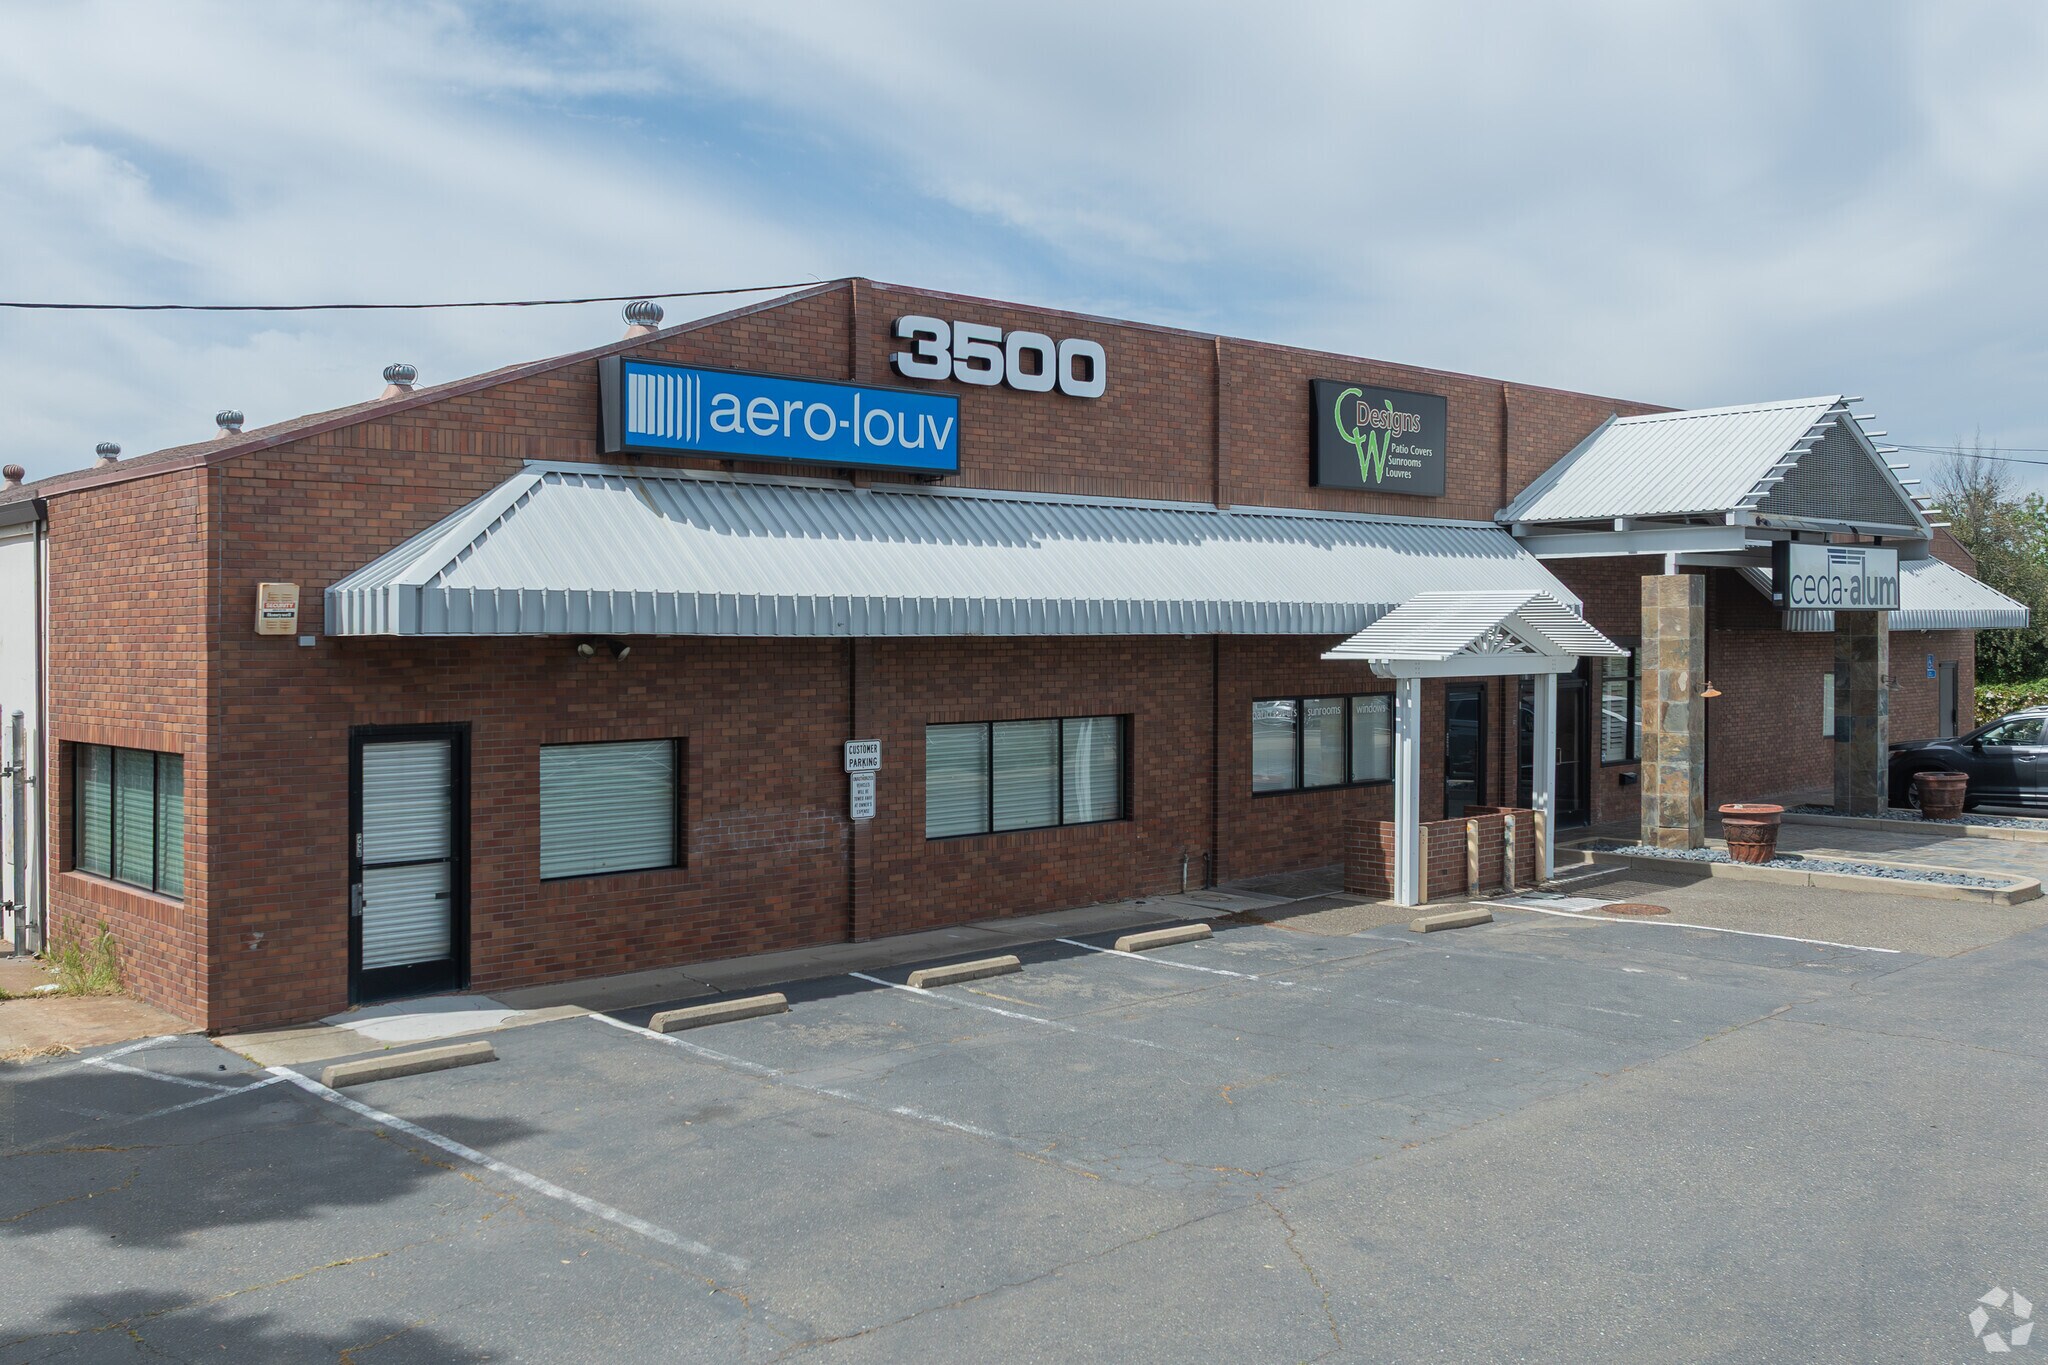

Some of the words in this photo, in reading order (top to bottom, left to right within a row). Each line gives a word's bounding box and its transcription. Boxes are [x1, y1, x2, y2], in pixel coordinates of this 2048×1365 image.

[893, 314, 1107, 398] 3500
[709, 391, 954, 450] aero-louv
[1356, 399, 1421, 438] Designs
[1391, 443, 1409, 454] Patio
[1410, 444, 1433, 457] Covers
[1388, 455, 1422, 468] Sunrooms
[1386, 467, 1412, 479] Louvres
[1307, 704, 1341, 716] sunrooms
[1356, 703, 1386, 714] windows
[848, 744, 878, 755] CUSTOMER
[849, 757, 878, 768] PARKING
